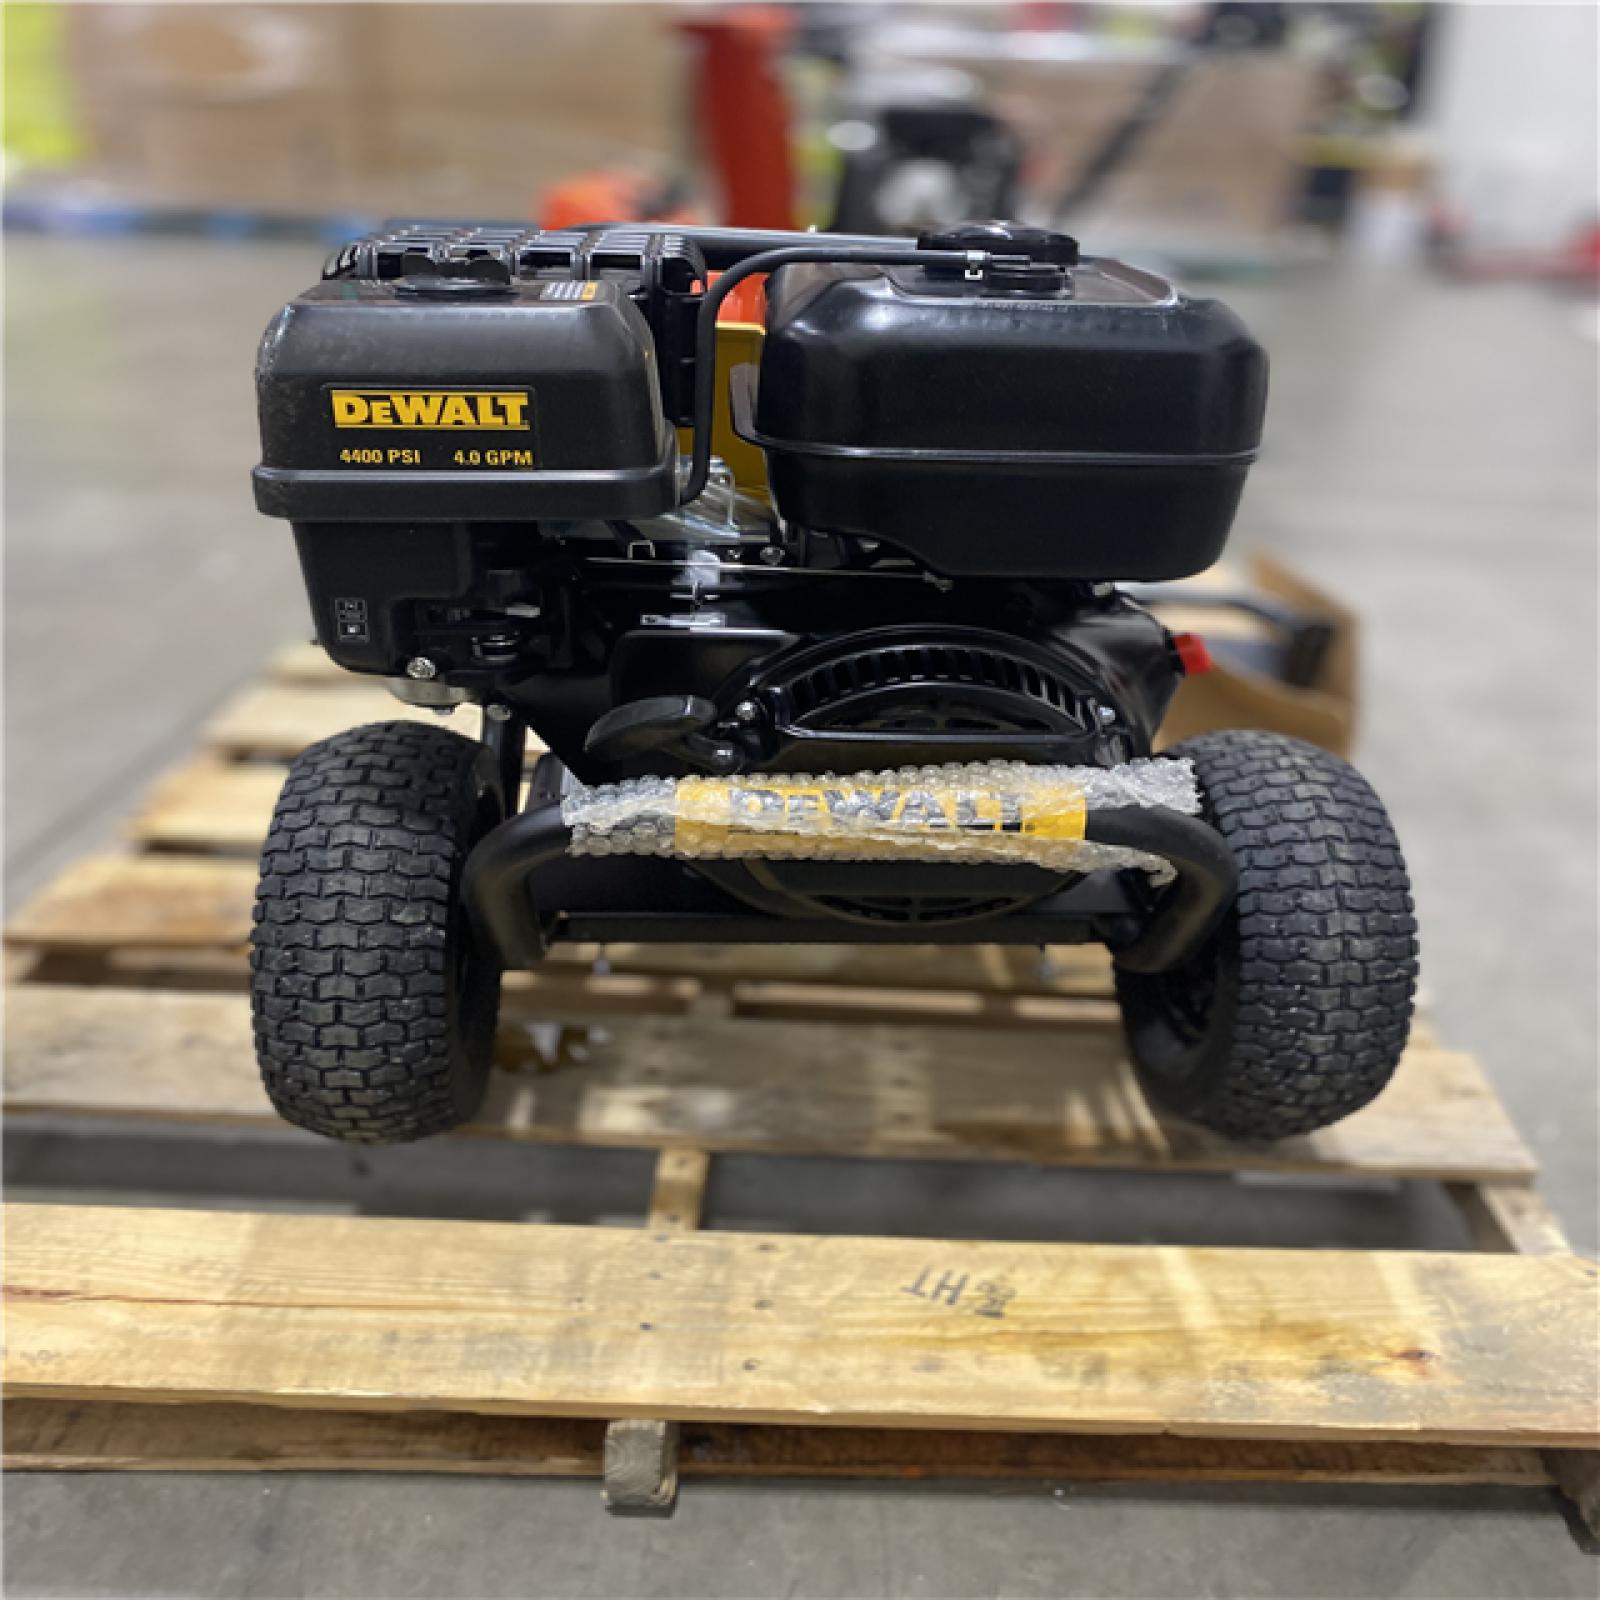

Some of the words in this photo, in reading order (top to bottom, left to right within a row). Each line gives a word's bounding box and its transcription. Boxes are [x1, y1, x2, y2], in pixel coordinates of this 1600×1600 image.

[332, 391, 530, 430] DEWALT
[340, 449, 383, 464] 4400
[387, 449, 421, 464] PSI
[454, 450, 481, 465] 4.0
[485, 450, 533, 466] GPM
[900, 1266, 969, 1306] HT
